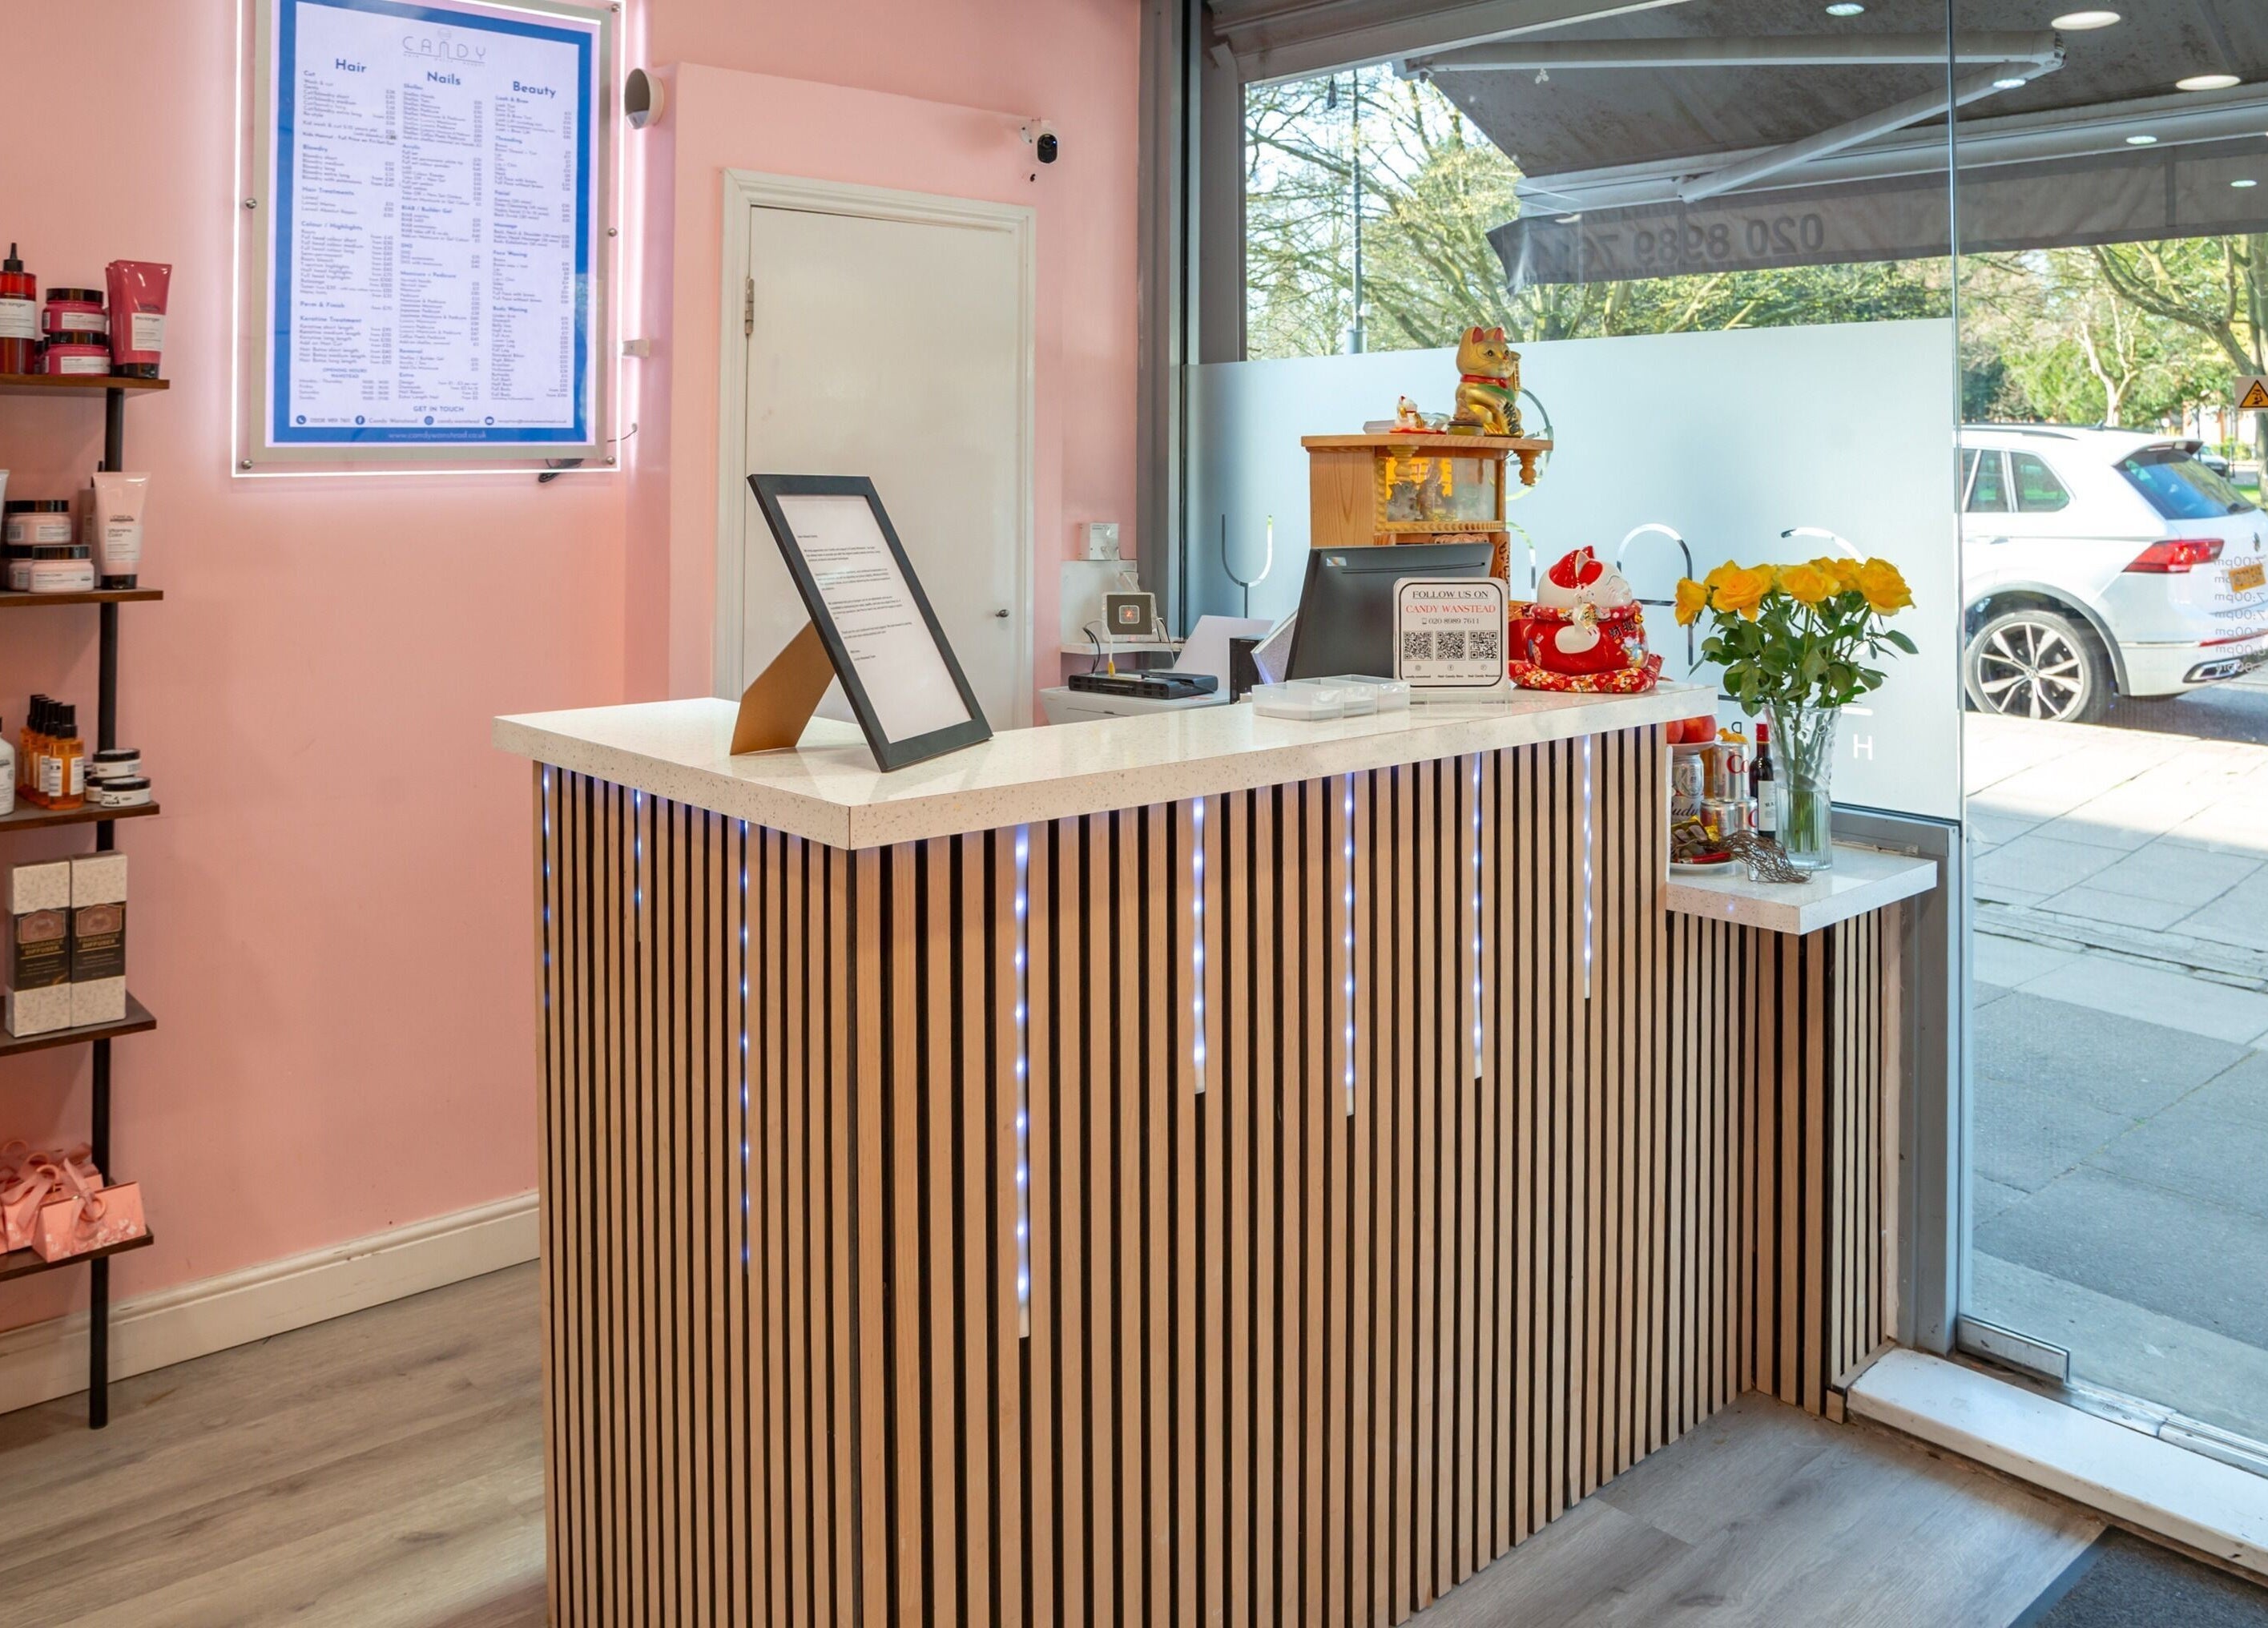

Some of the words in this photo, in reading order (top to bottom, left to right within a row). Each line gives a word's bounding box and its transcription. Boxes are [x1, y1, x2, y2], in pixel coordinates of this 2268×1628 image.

[403, 35, 485, 62] CANDY
[335, 58, 367, 73] Hair
[427, 70, 461, 85] Nails
[513, 81, 556, 98] Beauty
[329, 222, 362, 231] Highlights
[1412, 590, 1456, 598] FOLLOW
[1474, 590, 1489, 598] ON
[1405, 605, 1438, 614] CANDY
[1441, 604, 1497, 614] WANSTEAD
[82, 939, 115, 949] DIFFUSER
[25, 945, 60, 955] DIFFUSER
